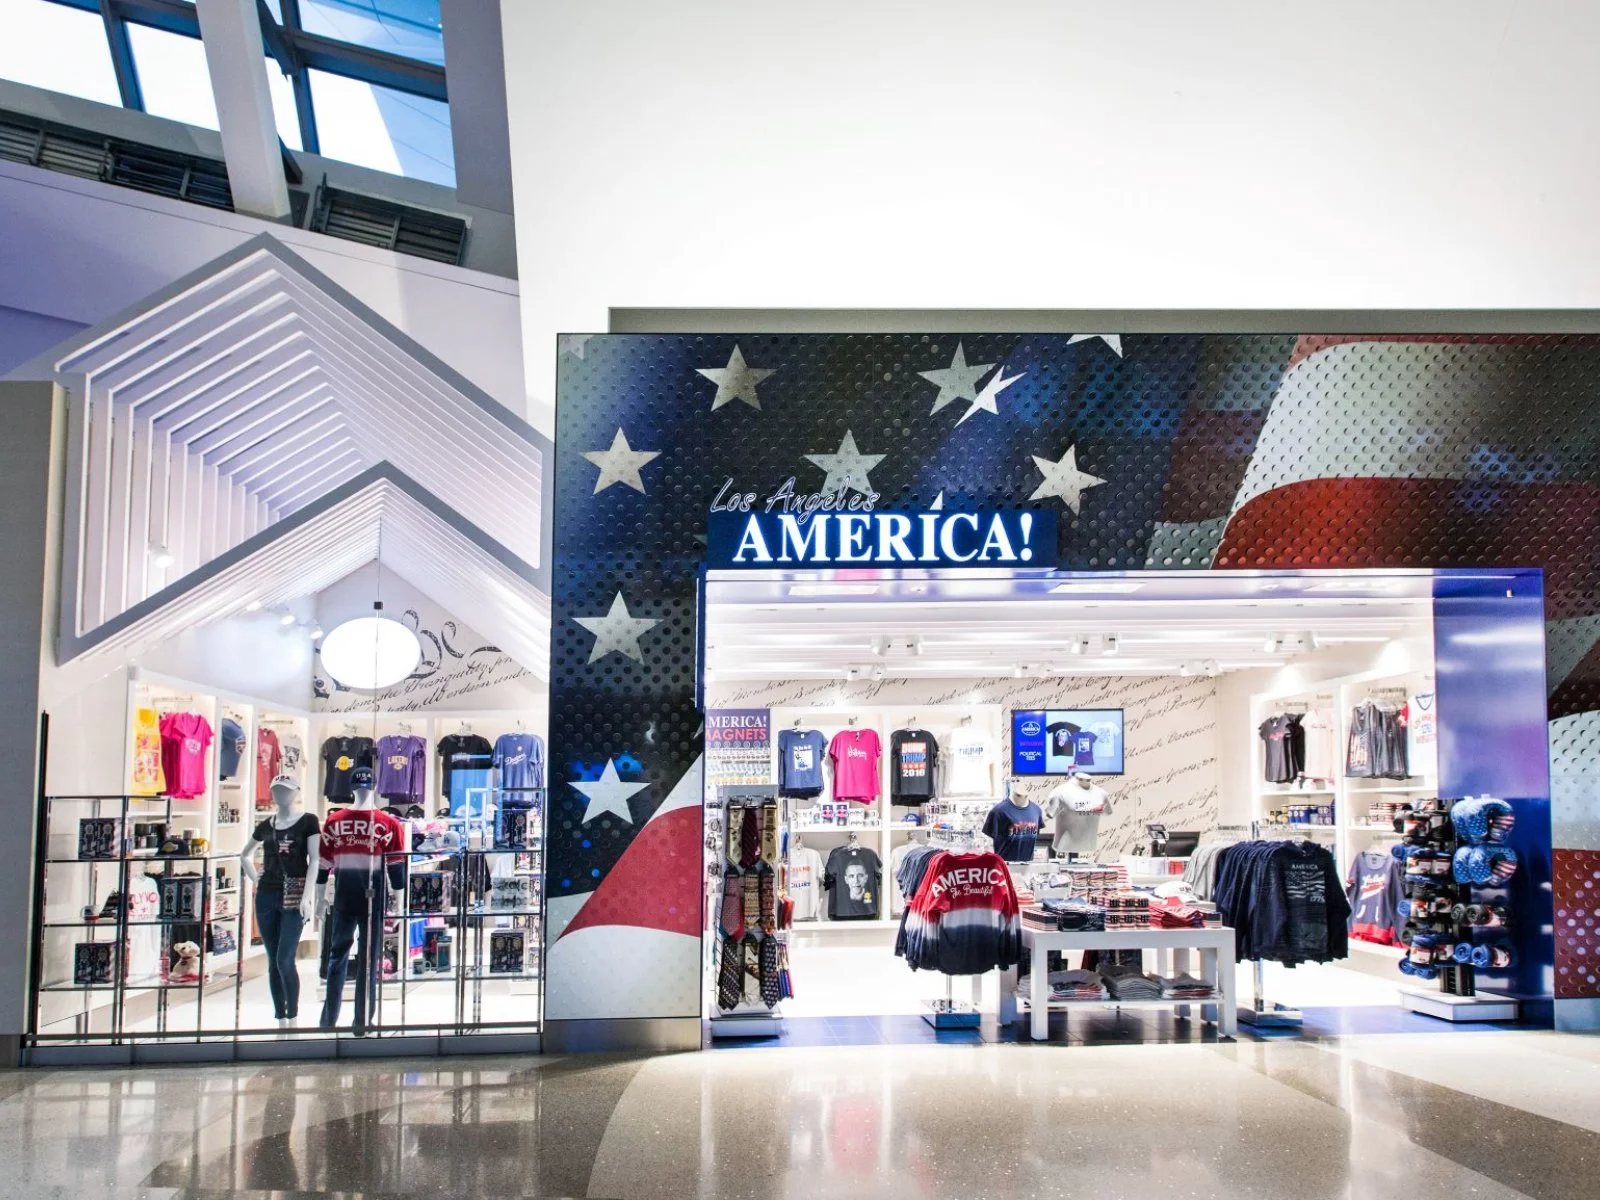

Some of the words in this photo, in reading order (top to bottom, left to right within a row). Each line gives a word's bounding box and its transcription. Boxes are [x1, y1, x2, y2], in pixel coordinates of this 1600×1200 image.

[710, 476, 757, 512] Los
[765, 475, 881, 525] Angeles
[732, 512, 1034, 562] AMERICA!
[902, 753, 926, 763] TRUMP
